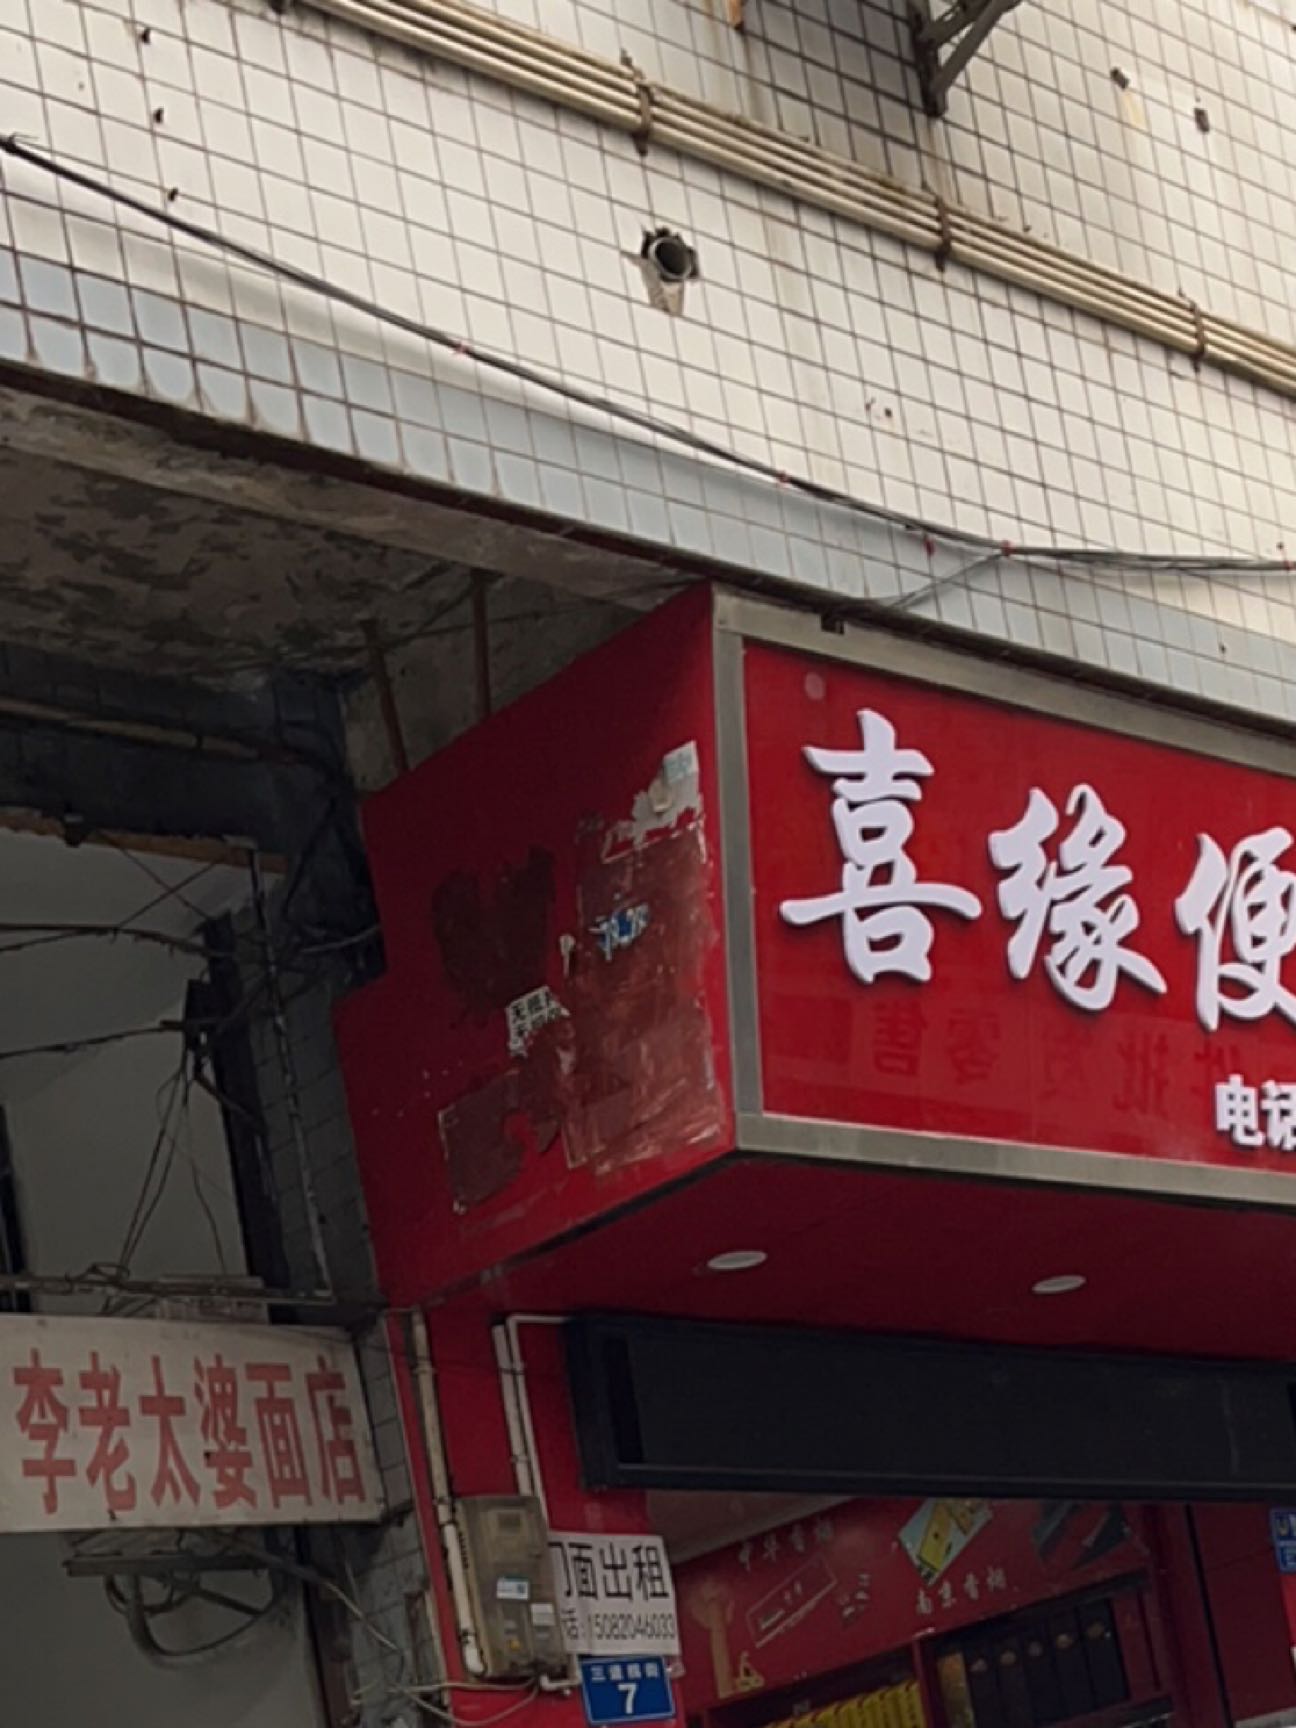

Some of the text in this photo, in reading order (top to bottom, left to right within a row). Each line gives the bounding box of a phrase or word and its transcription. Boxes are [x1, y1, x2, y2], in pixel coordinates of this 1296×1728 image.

[12, 1347, 367, 1516] 李老太婆面店
[617, 1682, 639, 1715] 7
